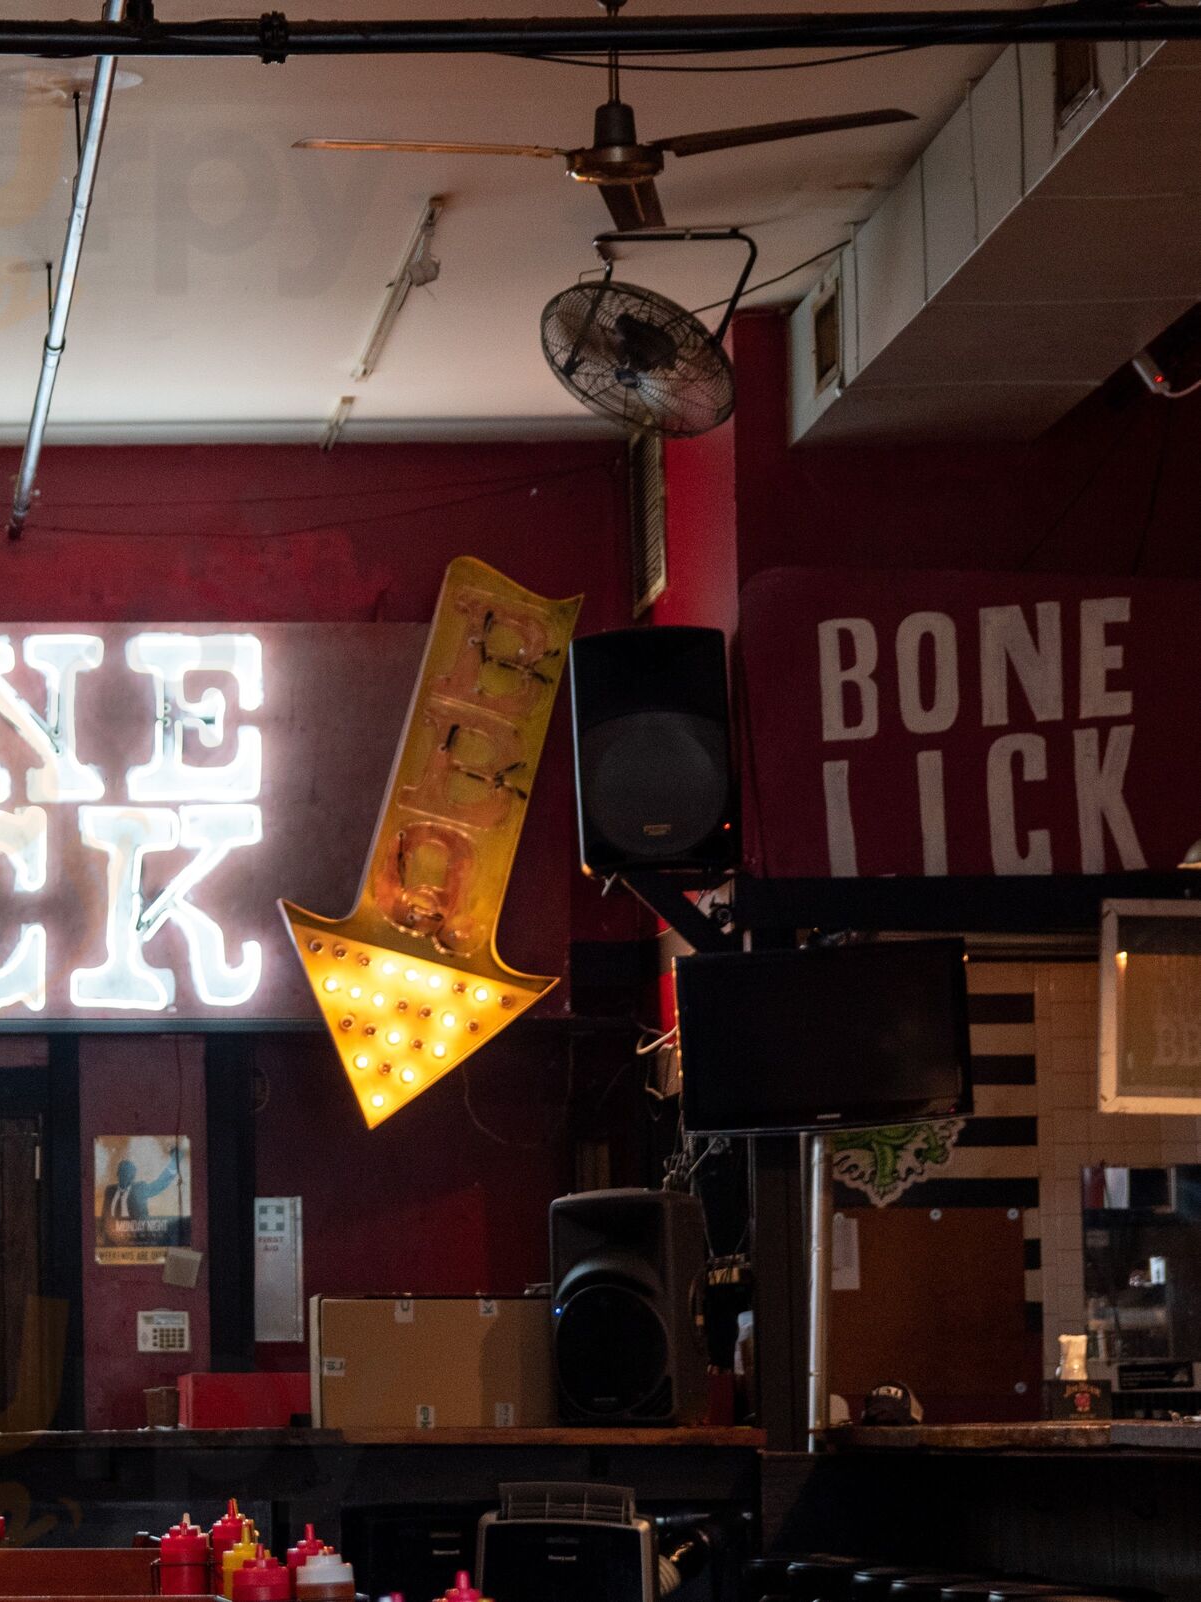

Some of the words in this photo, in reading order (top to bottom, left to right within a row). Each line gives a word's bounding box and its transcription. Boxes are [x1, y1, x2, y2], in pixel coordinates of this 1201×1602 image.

[818, 597, 1134, 742] BONE
[375, 585, 556, 958] BBQ
[258, 1236, 285, 1244] FIRST
